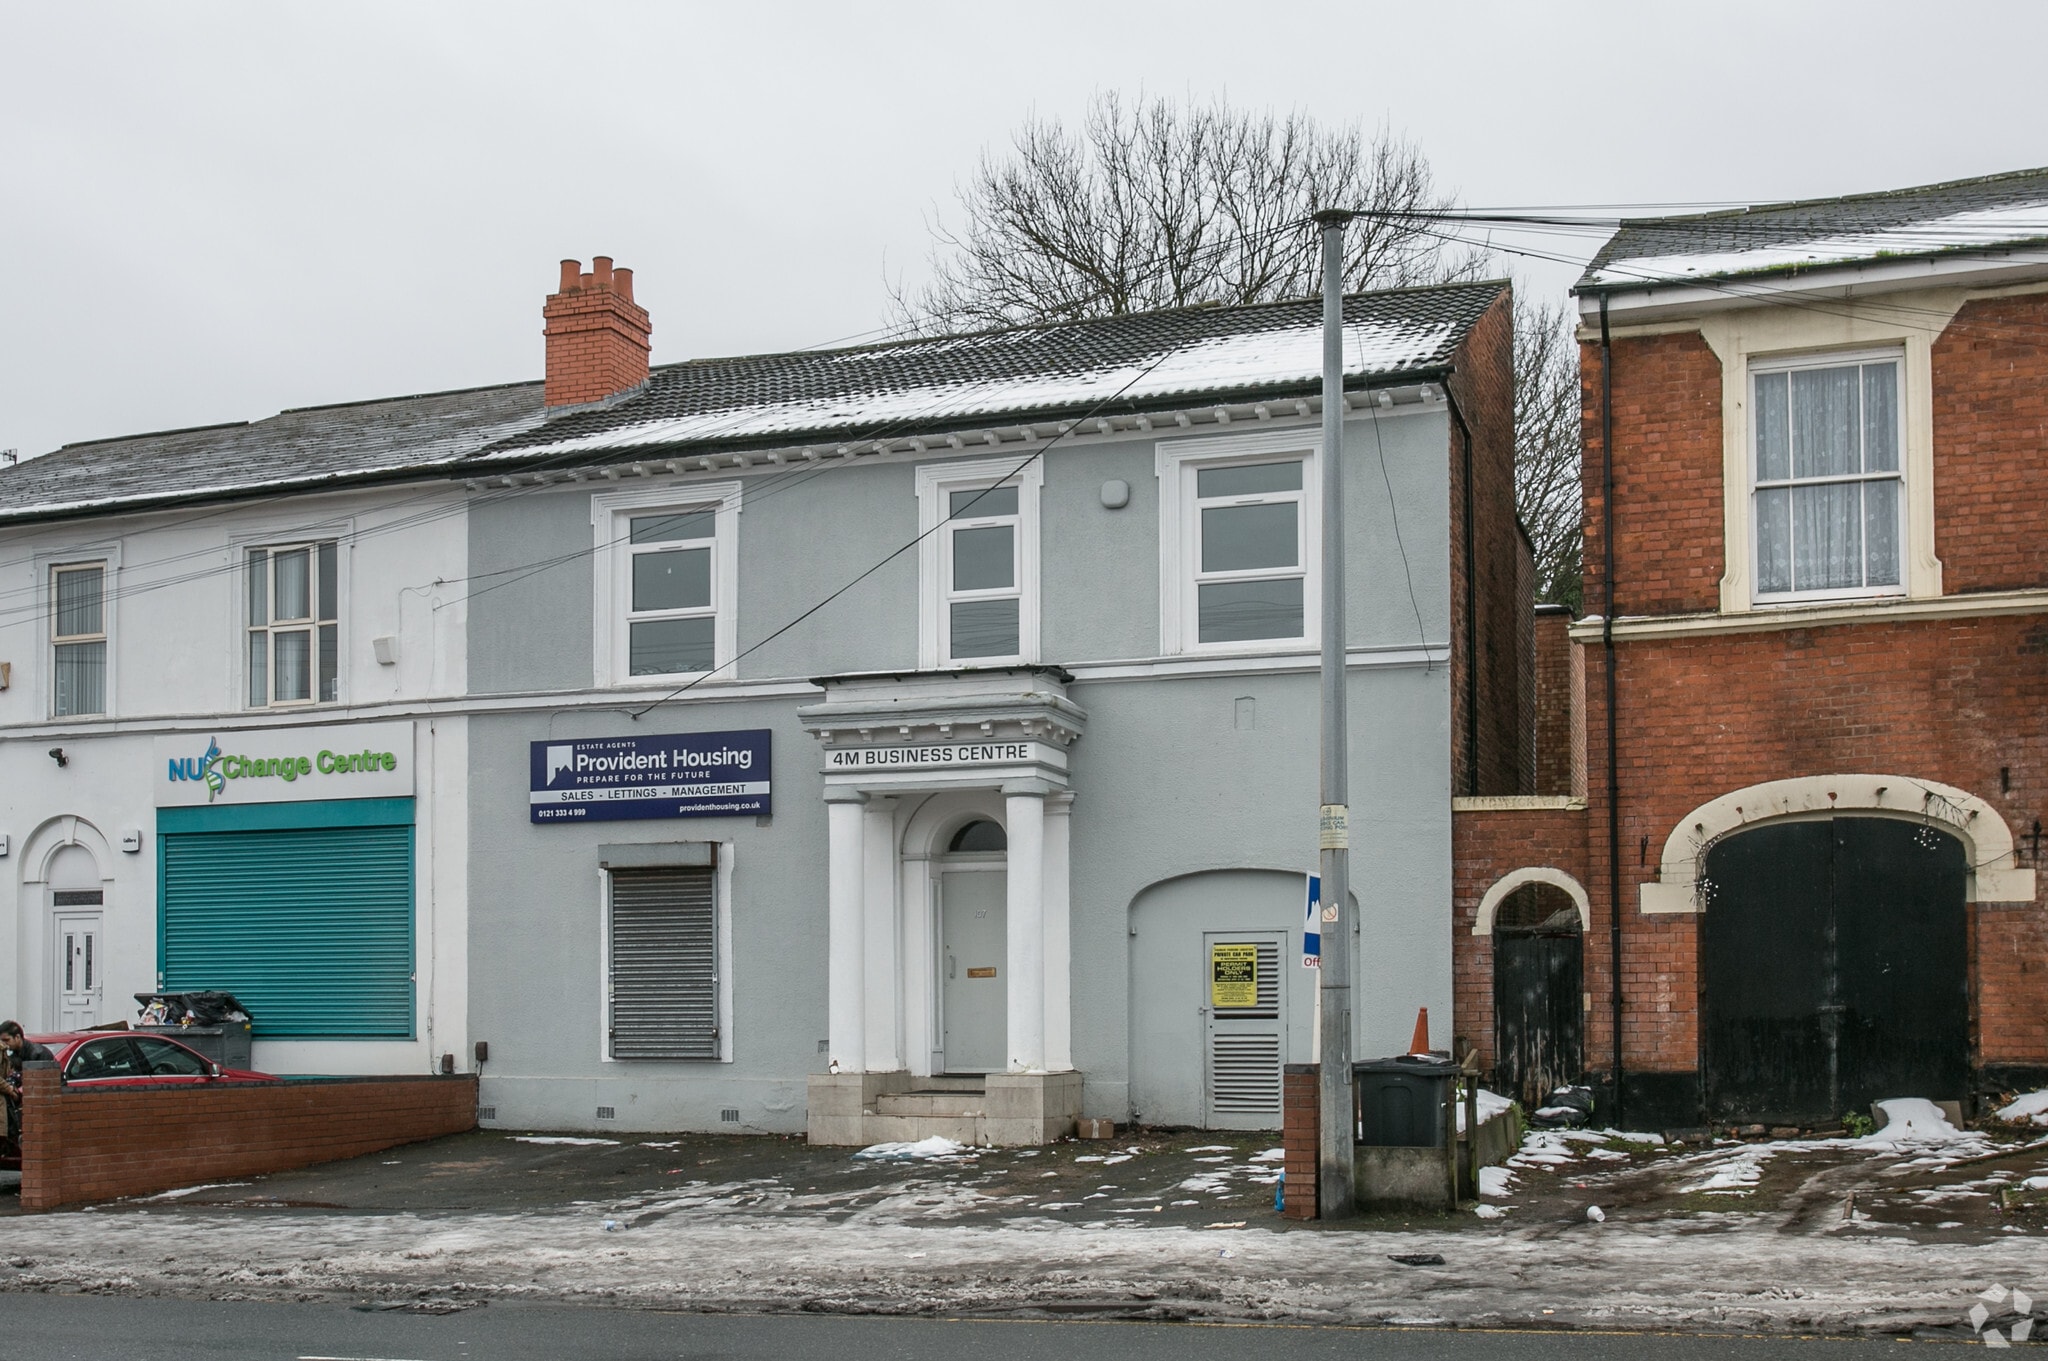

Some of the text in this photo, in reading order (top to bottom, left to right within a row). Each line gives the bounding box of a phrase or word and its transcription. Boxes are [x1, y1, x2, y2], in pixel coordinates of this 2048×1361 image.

[607, 741, 636, 749] AGENTS
[577, 746, 752, 772] Provident Housing
[833, 744, 1028, 766] 4M BUSINESS CENTRE
[222, 754, 312, 782] Change
[316, 749, 398, 774] Centre
[577, 770, 711, 784] PREPARE FOR THE FUTURE
[561, 790, 594, 801] SALES
[608, 788, 657, 799] LETTINGS
[671, 784, 746, 796] MANAGEMENT
[538, 809, 554, 818] 0121
[555, 809, 567, 817] 333
[679, 801, 761, 813] providenthousing.co.uk
